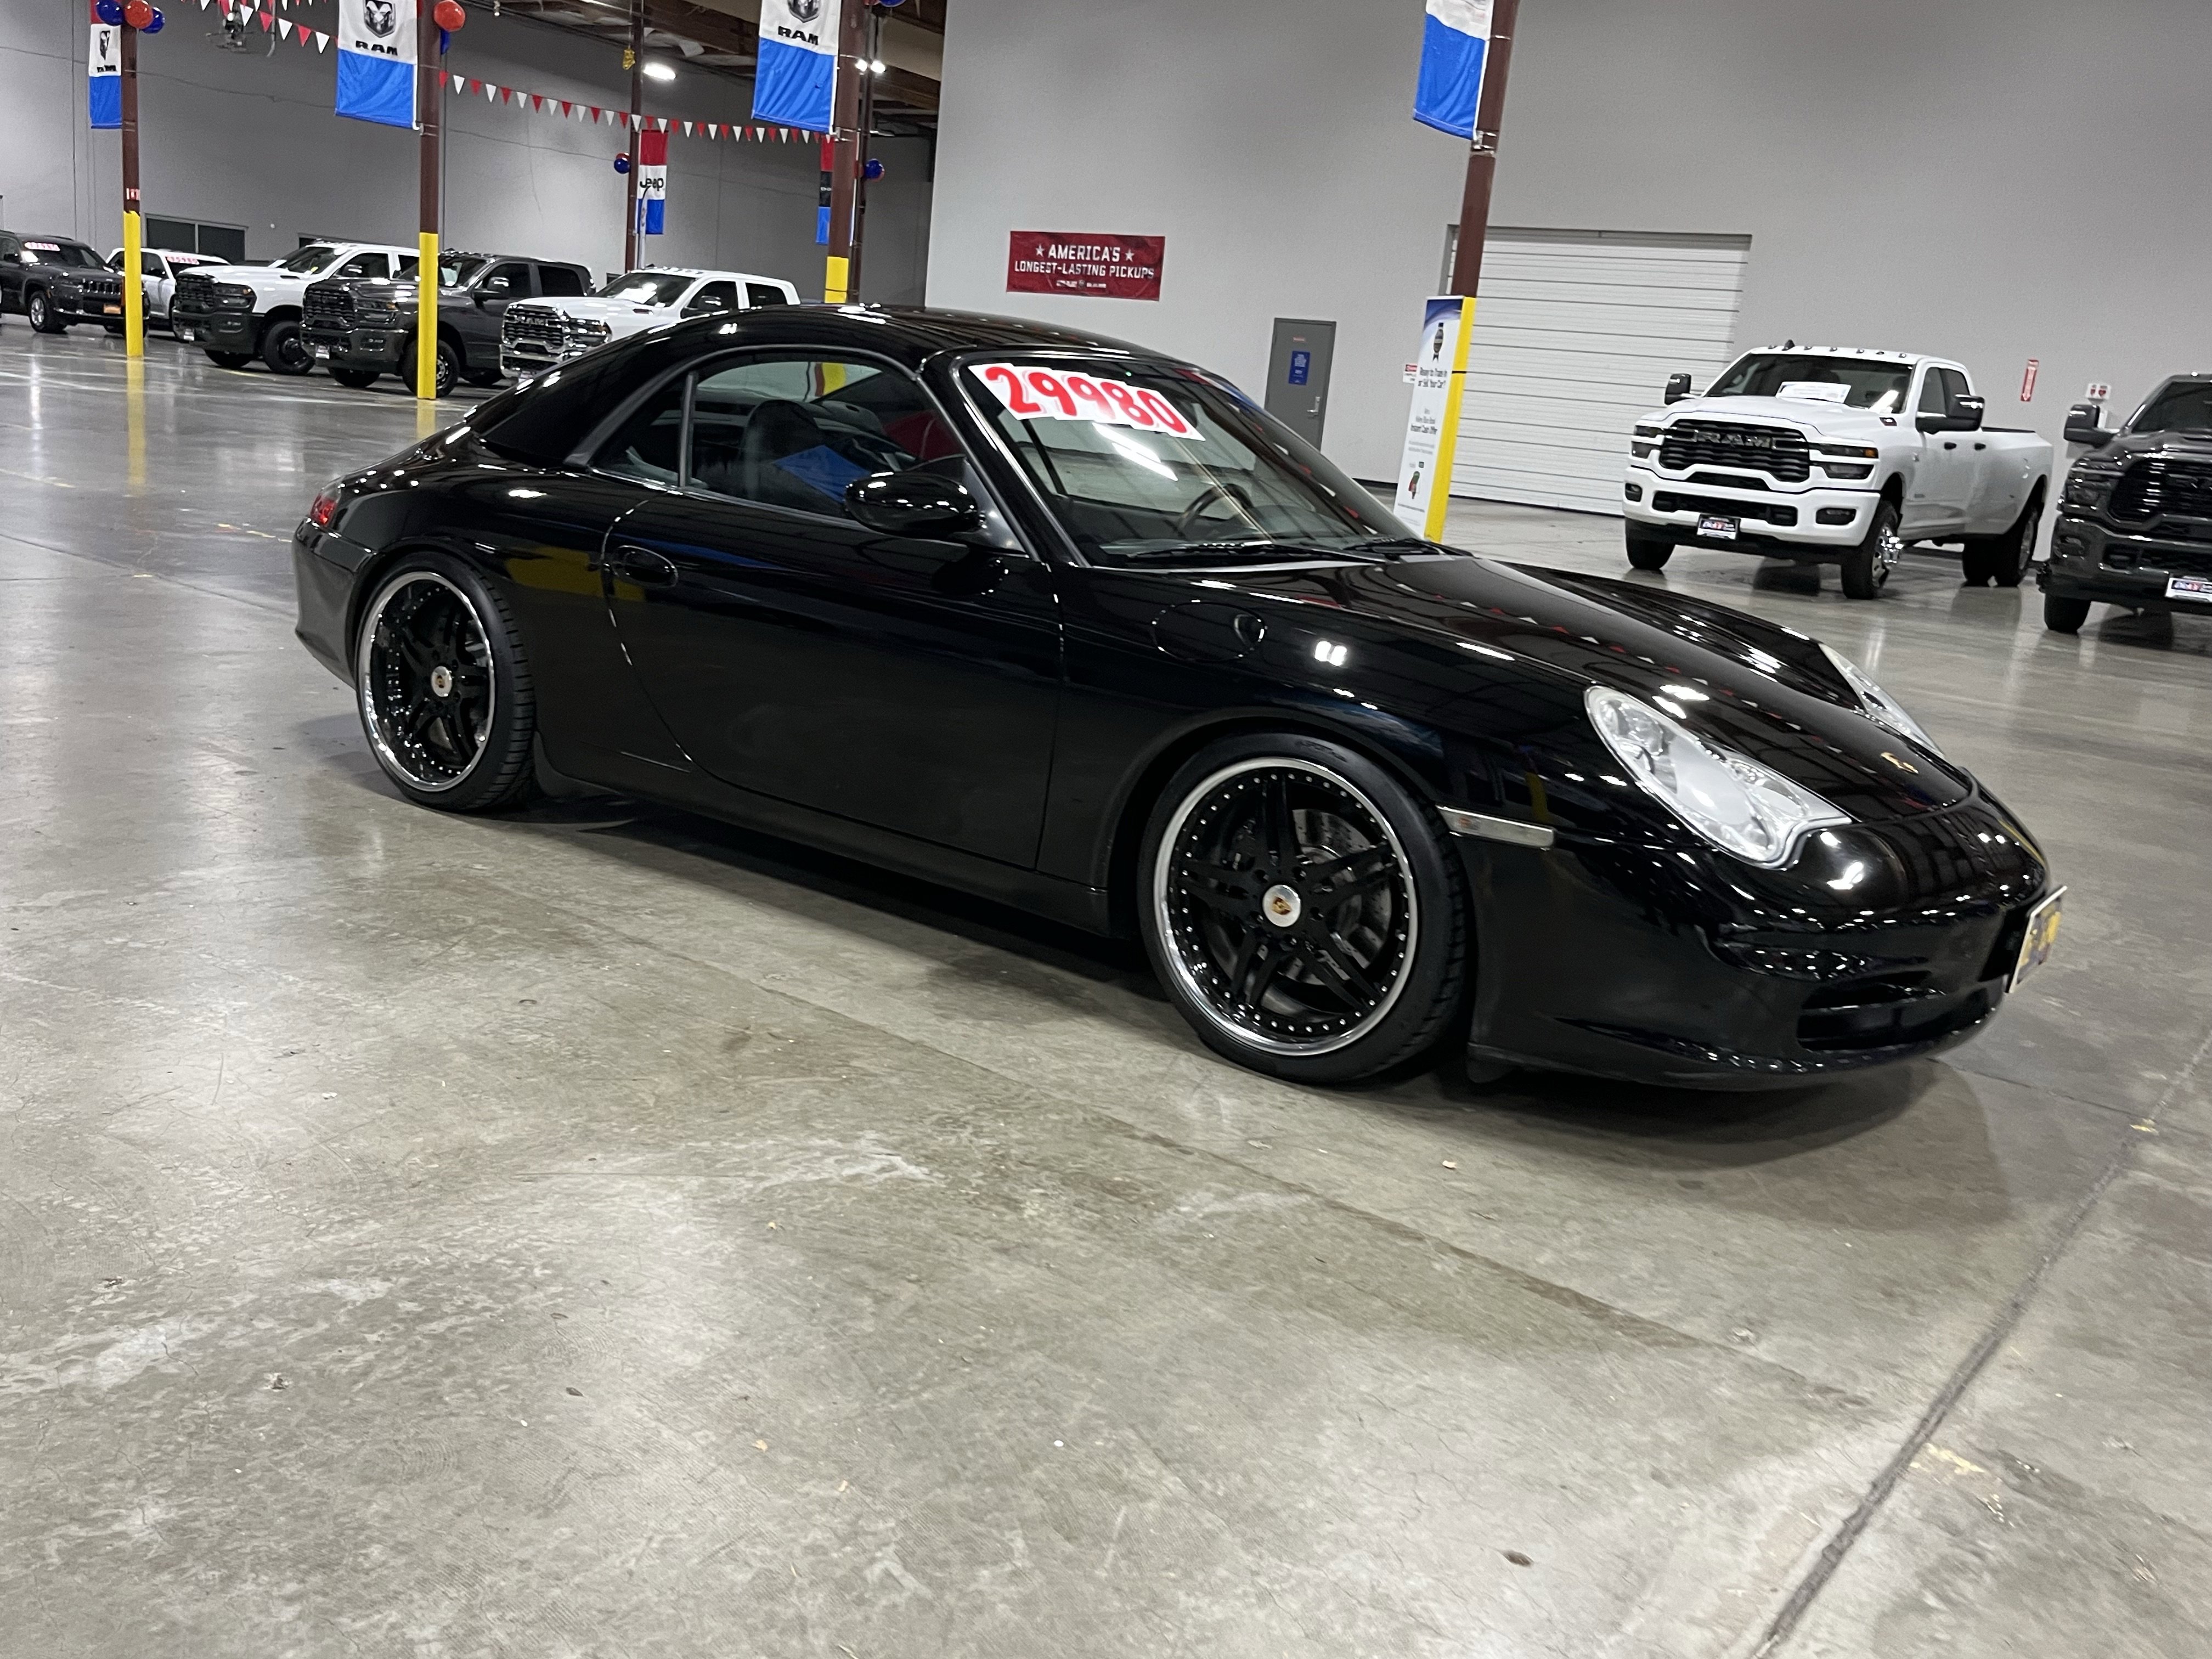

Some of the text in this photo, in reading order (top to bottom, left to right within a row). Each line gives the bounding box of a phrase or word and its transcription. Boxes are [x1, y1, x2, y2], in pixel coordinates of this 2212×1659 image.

[777, 25, 819, 46] RAM
[356, 40, 398, 56] RAM
[1048, 244, 1121, 262] AMERICA'S
[1014, 261, 1154, 279] LONGEST-LASTING PICKUPS
[985, 366, 1188, 433] 29980
[1696, 431, 1771, 448] RAM
